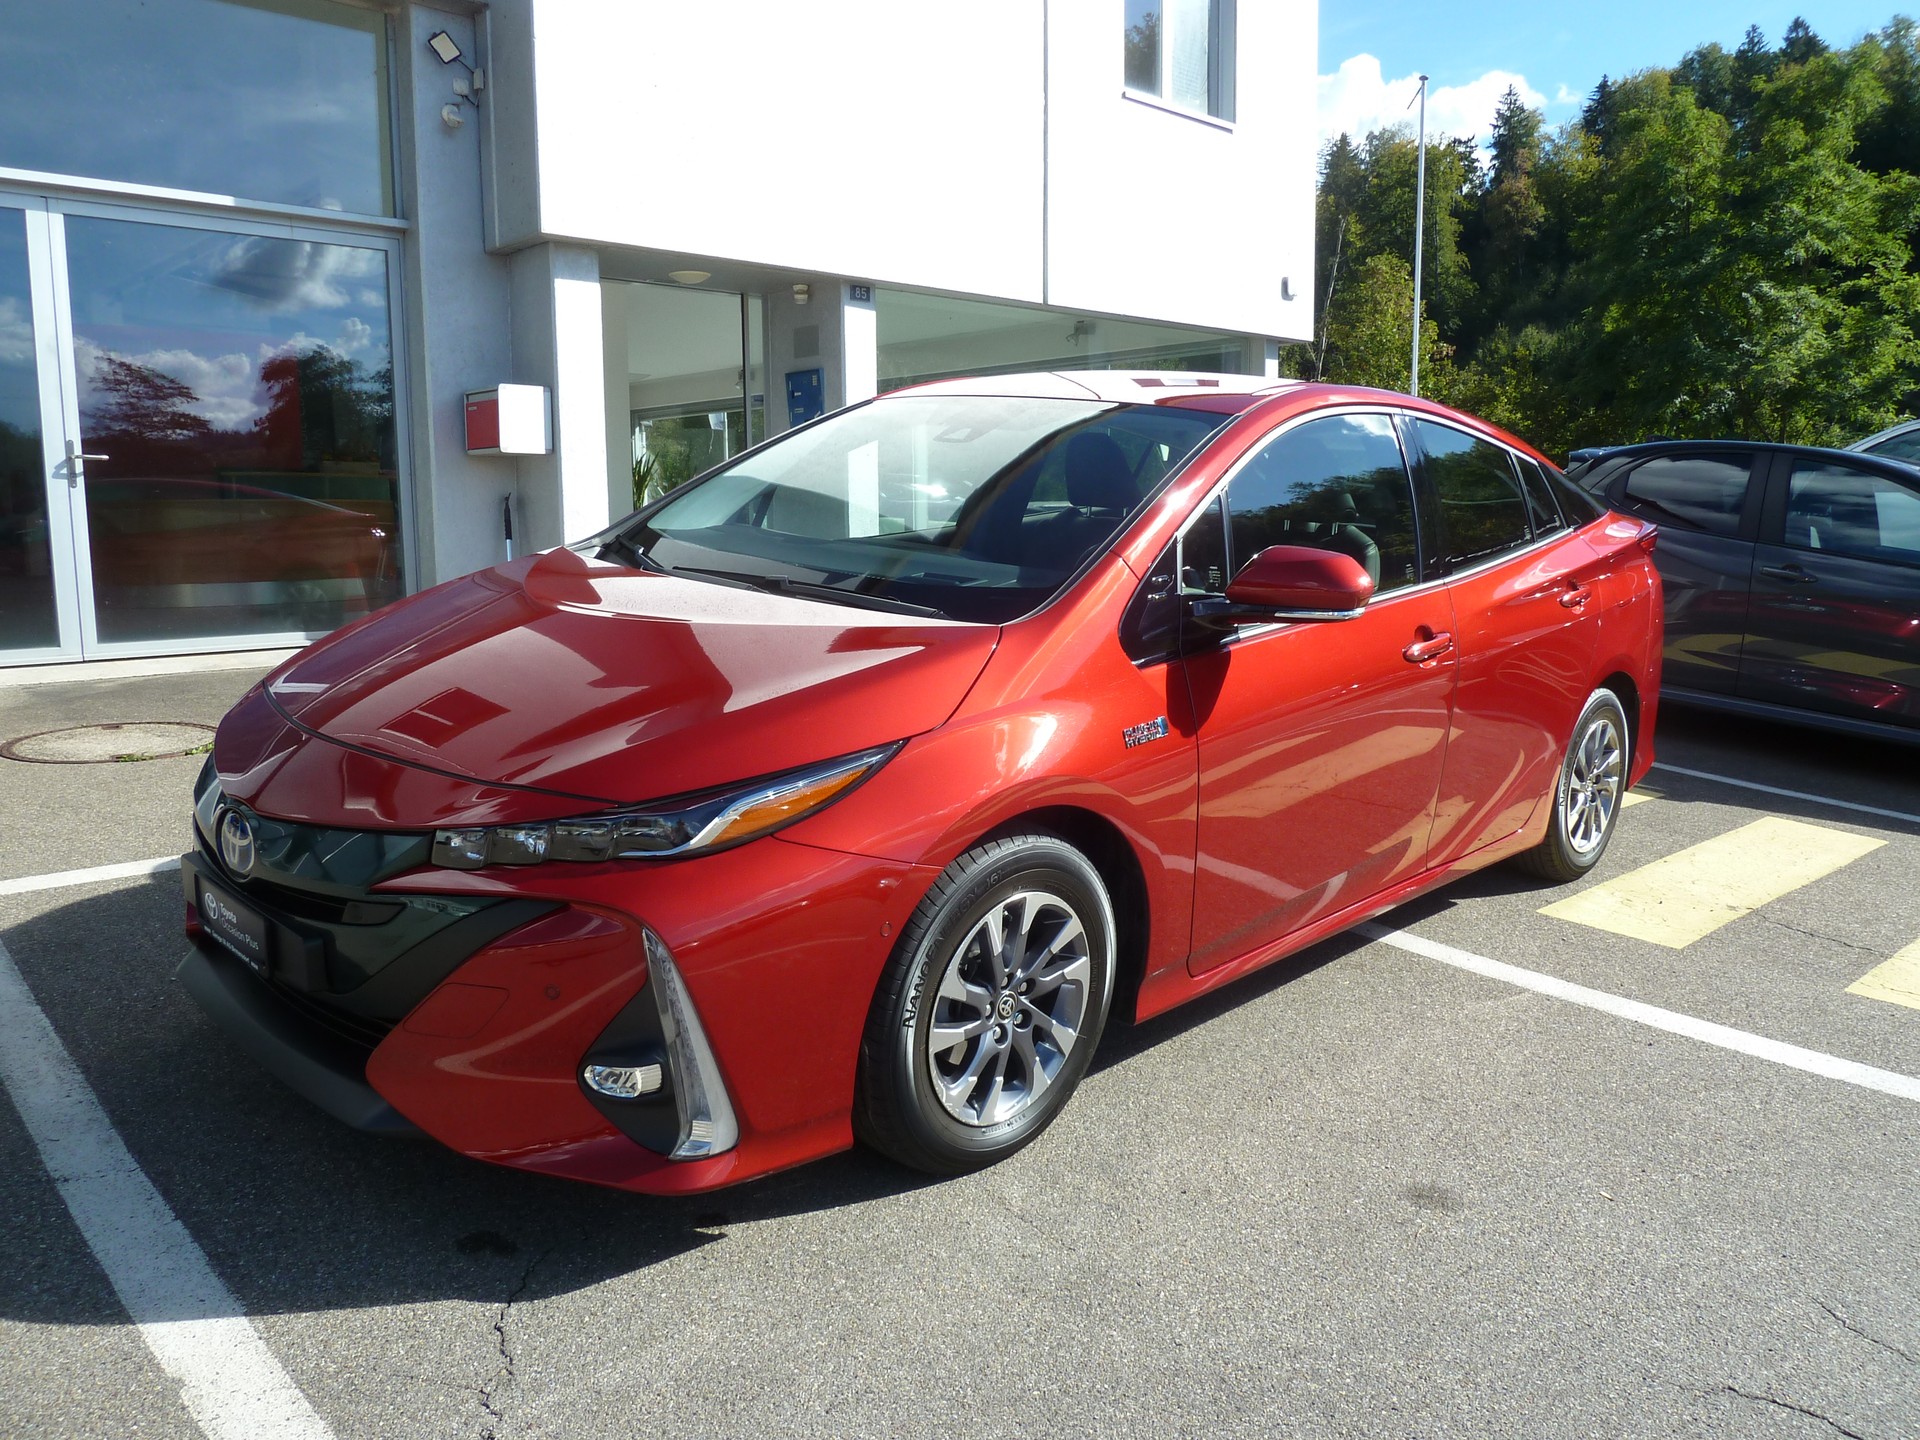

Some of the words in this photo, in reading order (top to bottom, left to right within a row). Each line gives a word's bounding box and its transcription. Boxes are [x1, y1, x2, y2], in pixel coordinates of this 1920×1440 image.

[855, 287, 867, 300] 85
[219, 902, 237, 924] Toyota
[245, 933, 259, 950] Plus
